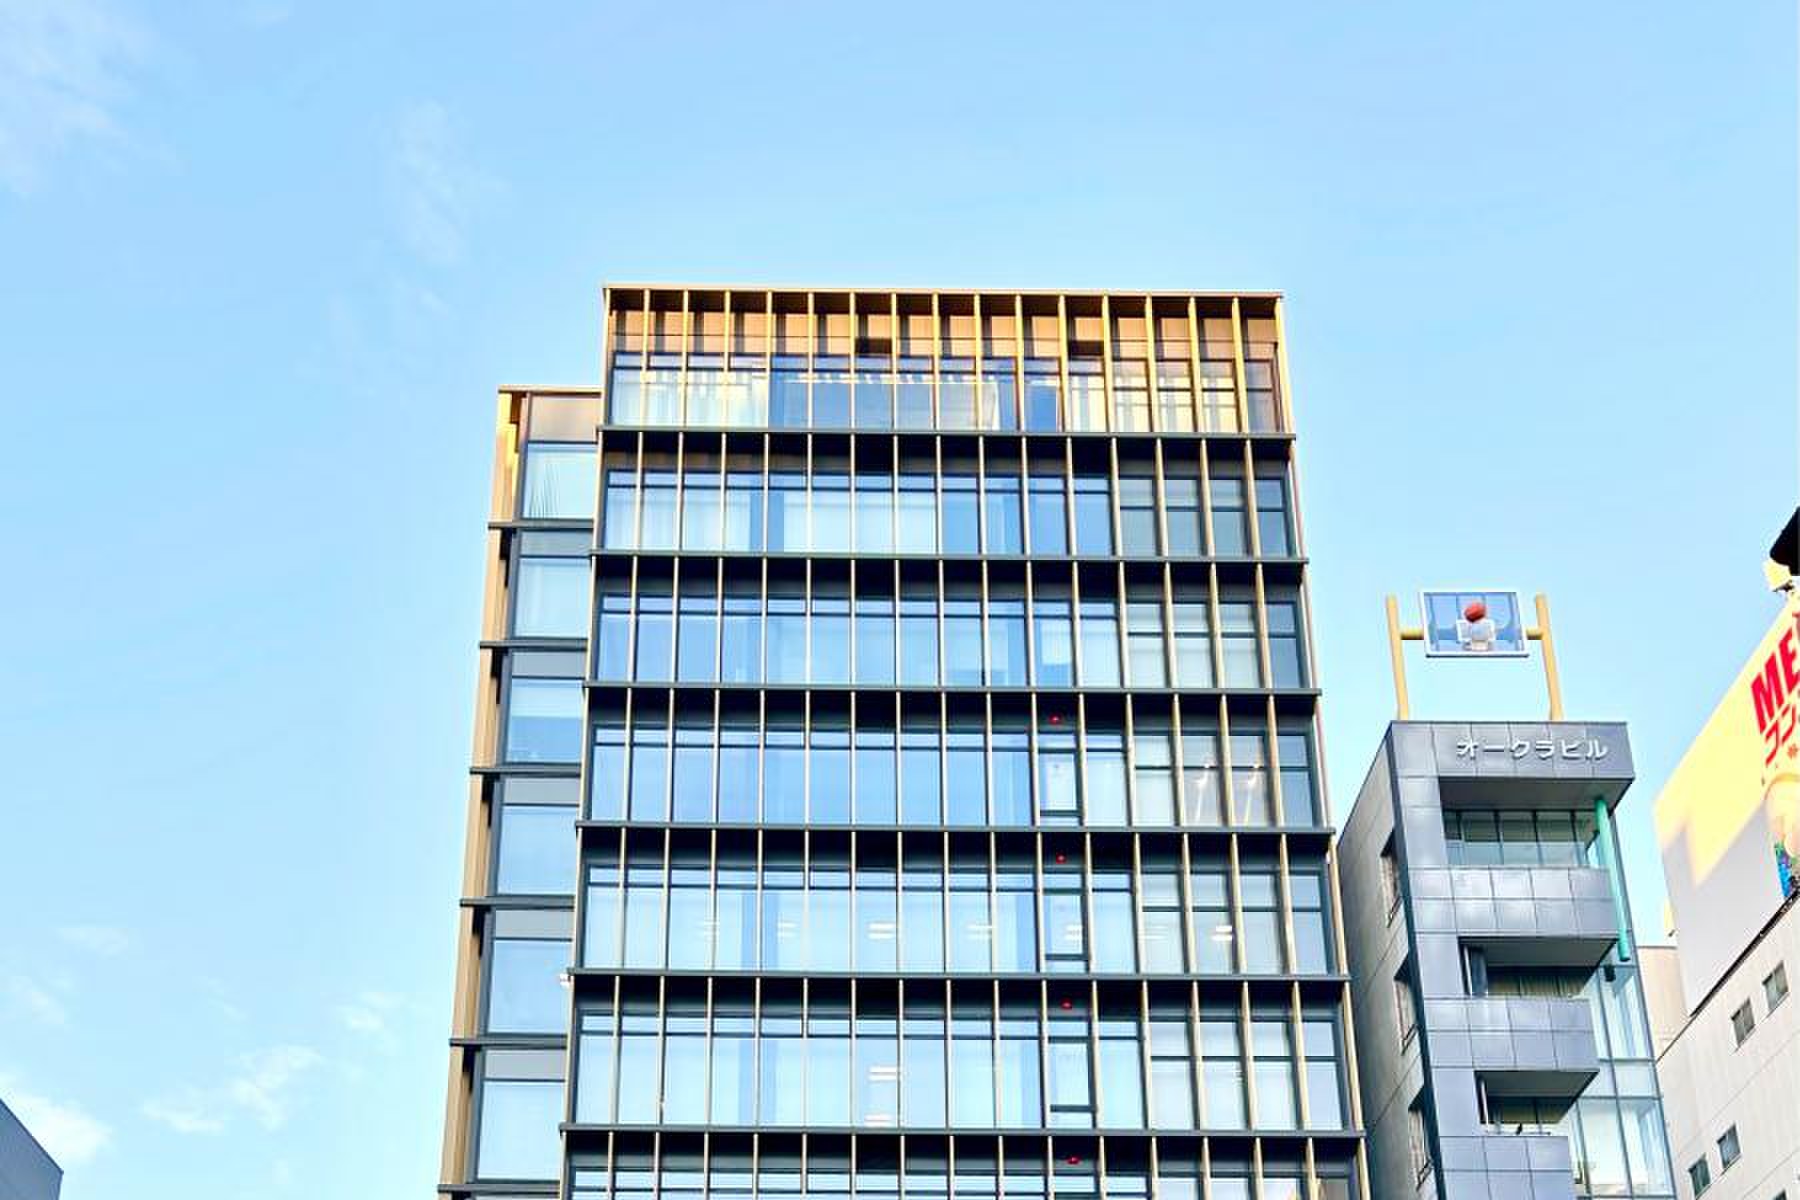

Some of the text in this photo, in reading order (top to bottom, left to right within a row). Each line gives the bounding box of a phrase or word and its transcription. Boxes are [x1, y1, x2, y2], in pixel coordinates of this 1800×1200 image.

[1456, 739, 1608, 761] オークラビル
